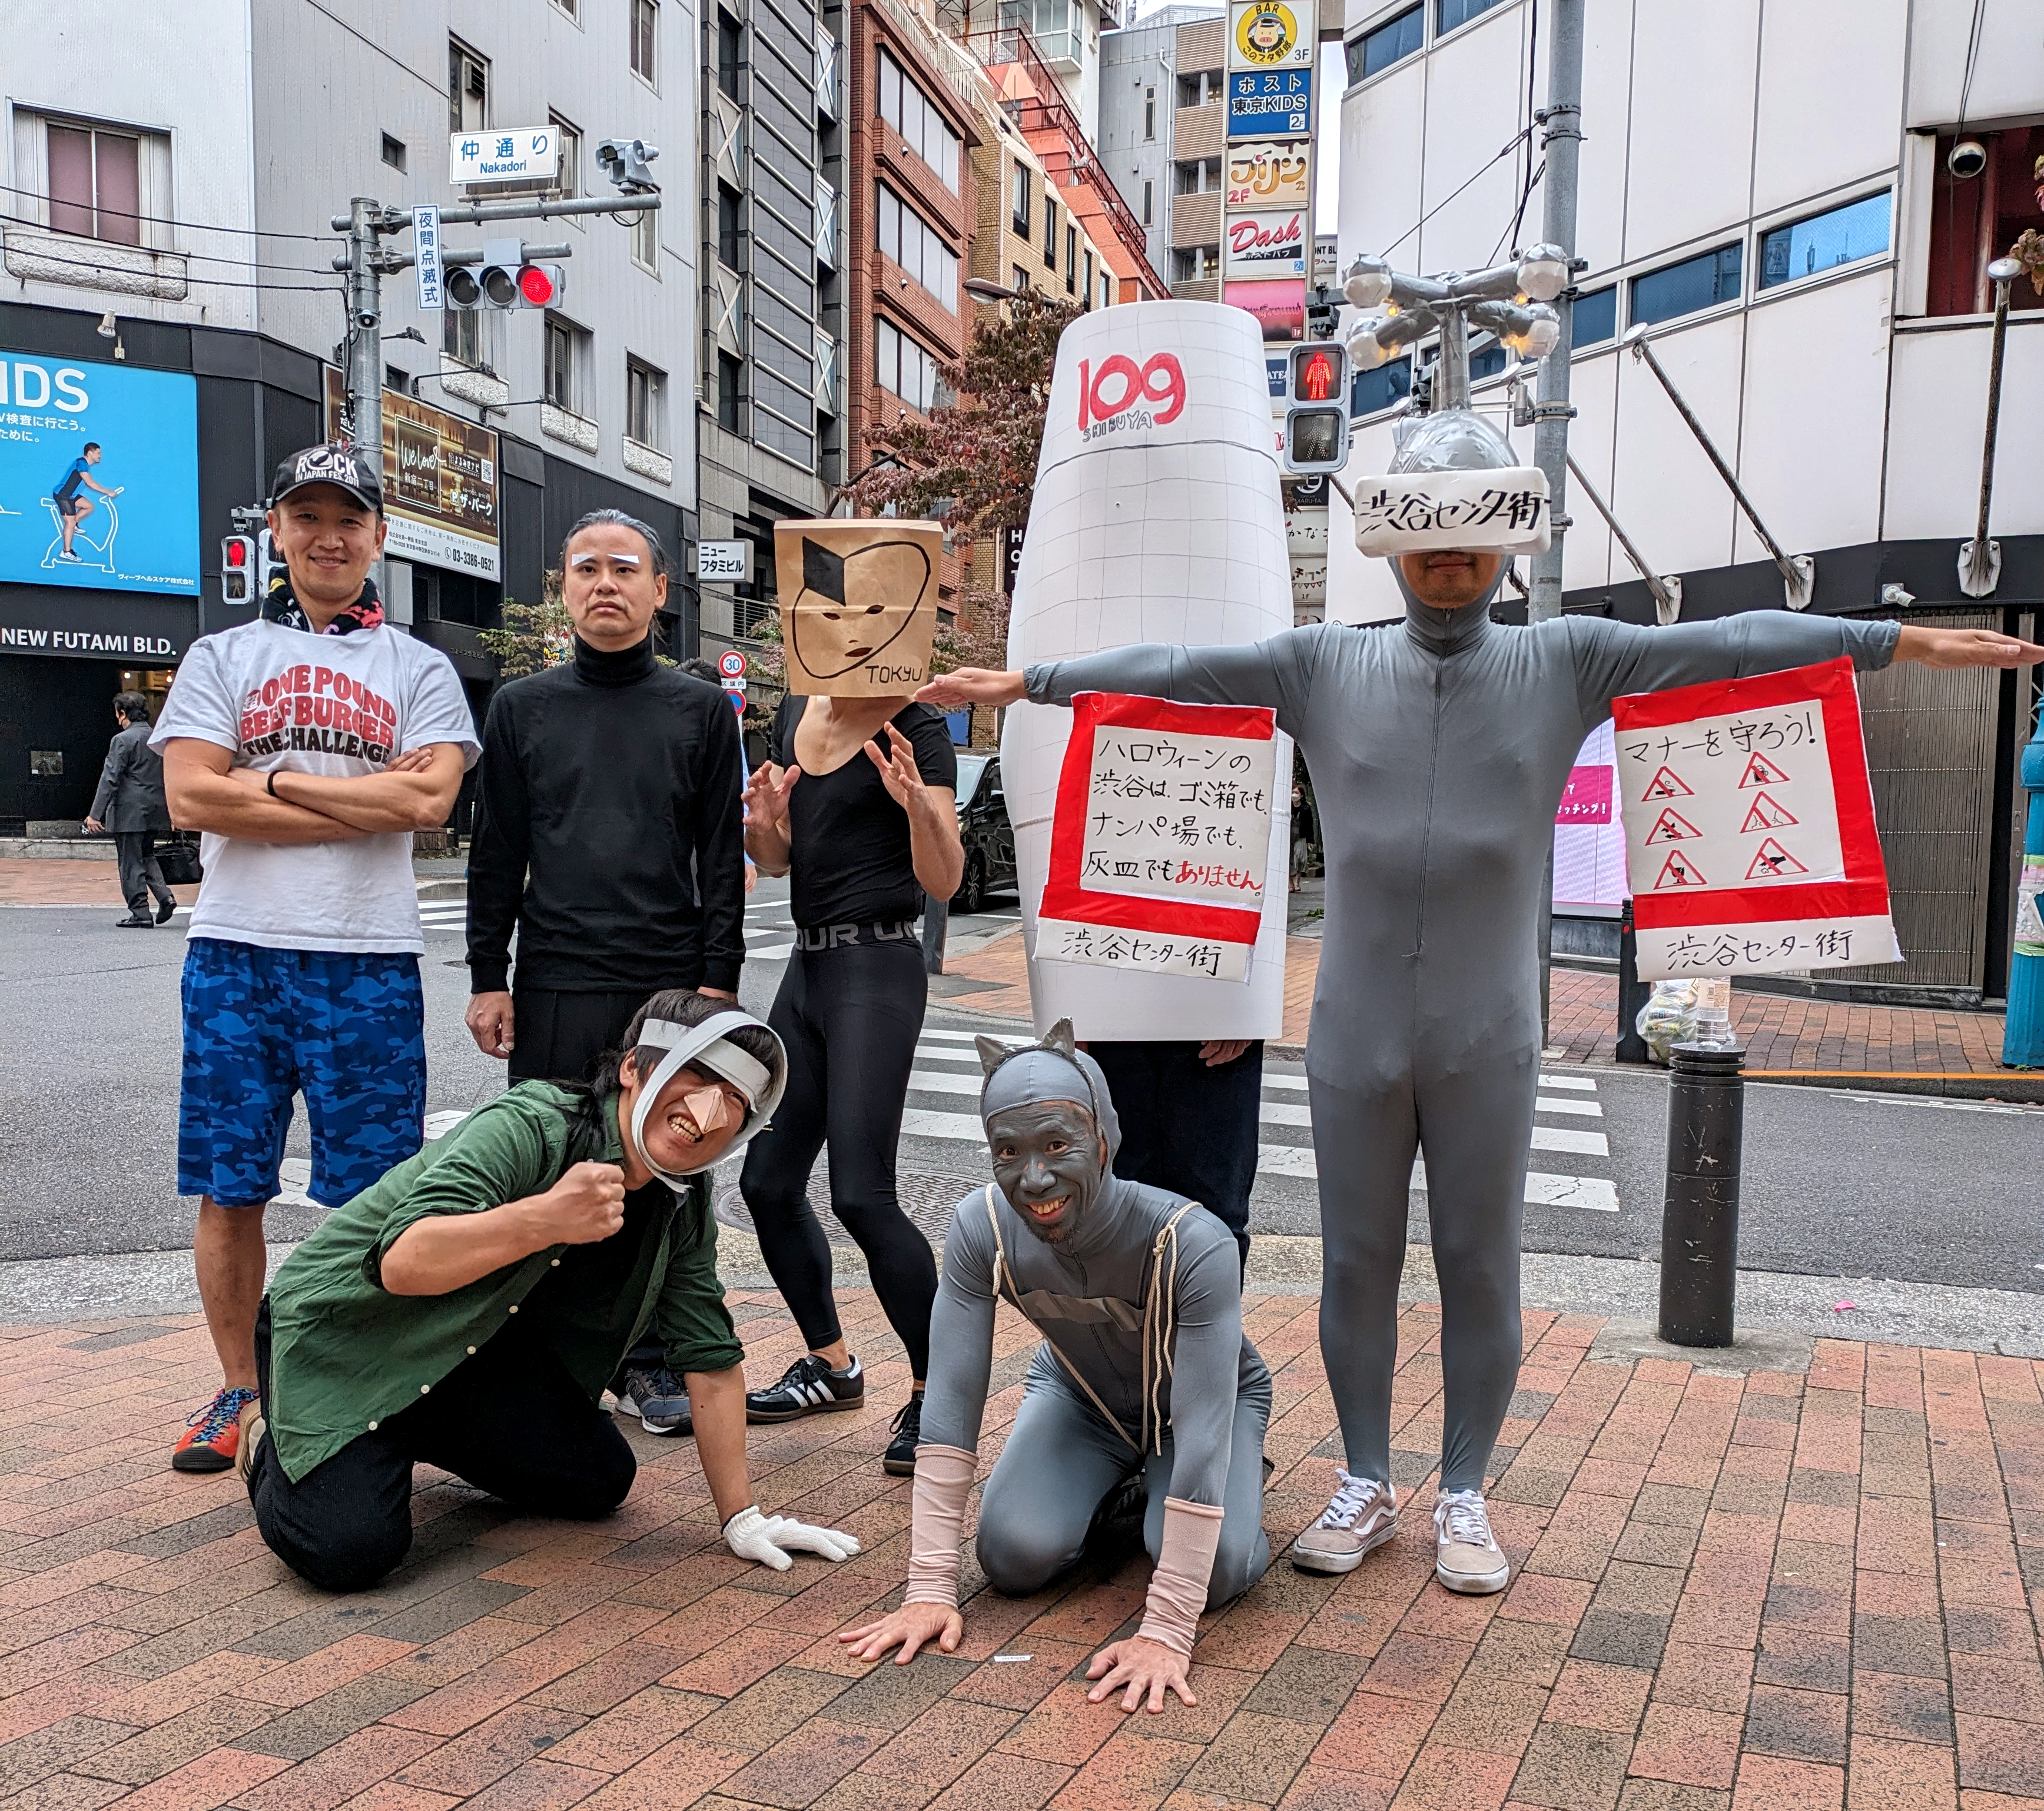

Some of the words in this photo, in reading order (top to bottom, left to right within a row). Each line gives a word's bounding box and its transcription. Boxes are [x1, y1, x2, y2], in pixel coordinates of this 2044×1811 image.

[1256, 2, 1280, 15] BAR
[1242, 41, 1293, 63] このブタ野郎
[1294, 49, 1309, 61] 3F
[1239, 74, 1302, 94] ホスト
[1232, 94, 1308, 116] 東京KIDS
[1291, 115, 1305, 129] 2F
[461, 134, 549, 162] 仲通り
[480, 159, 527, 174] Nakadori
[1230, 154, 1306, 195] プリン
[1228, 188, 1250, 203] 2F
[1229, 214, 1301, 252] Dash
[419, 212, 438, 303] 夜間点滅式
[1245, 249, 1291, 260] ホストパブ
[1295, 262, 1303, 271] 2F
[1078, 352, 1186, 431] 109
[1082, 410, 1152, 443] SHIBUYA
[296, 451, 359, 479] ROCK
[401, 440, 417, 469] We
[296, 473, 303, 483] IN
[304, 470, 327, 481] JAPAN
[328, 471, 344, 481] FES.
[344, 475, 359, 489] 2011
[404, 472, 434, 491] 新宿二丁目
[1358, 489, 1551, 534] 渋谷センター街
[453, 548, 495, 572] 03-3386-0521
[701, 546, 728, 557] ニュー
[699, 559, 744, 574] フタミビル
[118, 573, 195, 586] ヴィーブヘルスケア株式会社
[1, 627, 48, 647] NEW
[53, 631, 128, 652] FUTAMI
[134, 636, 177, 656] BLD.
[725, 659, 740, 670] 30
[865, 664, 923, 684] TOKYU
[262, 664, 311, 707] ONE
[313, 666, 397, 727] POUND
[240, 697, 293, 742] BEEF
[294, 696, 395, 749] BURGER
[243, 732, 284, 756] THE
[1624, 712, 1816, 763] マナーを守ろう!
[1099, 739, 1251, 773] ハロウィーンの
[1061, 928, 1223, 976] 渋谷センター街
[1666, 929, 1854, 971] 渋谷センター街
